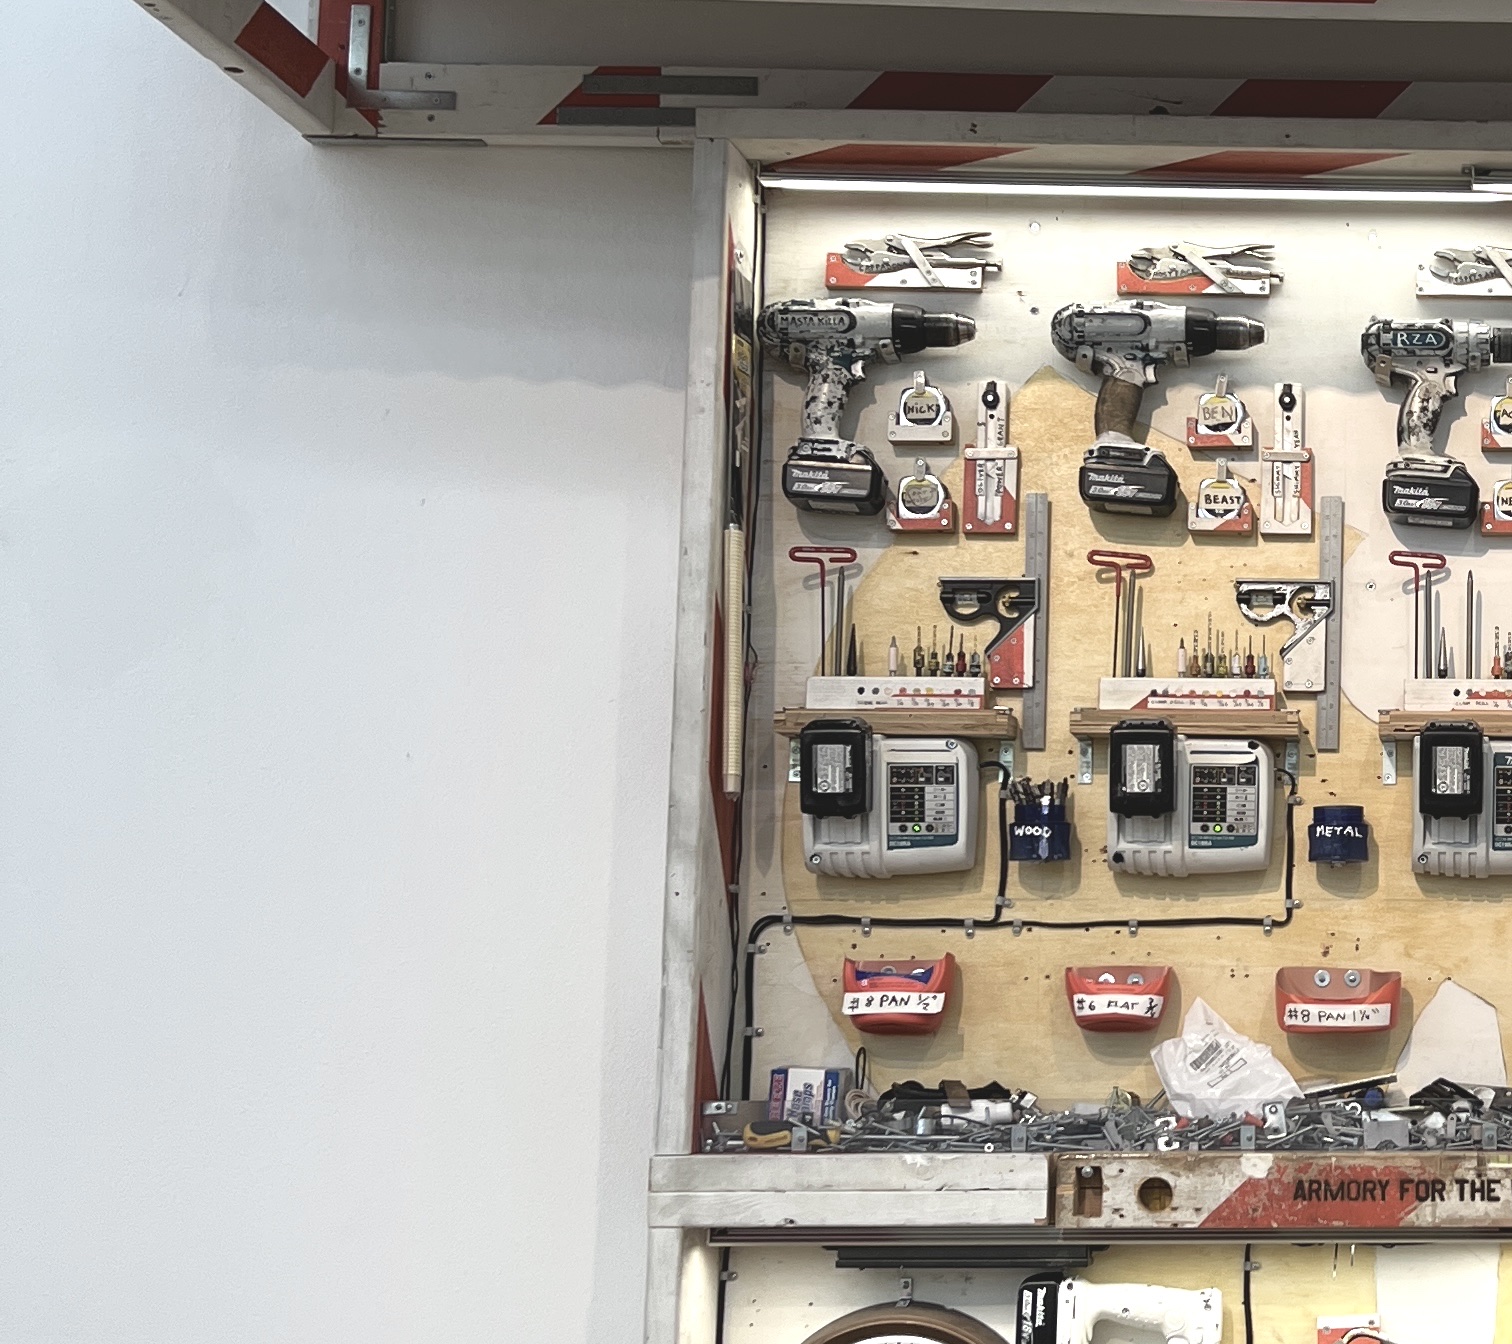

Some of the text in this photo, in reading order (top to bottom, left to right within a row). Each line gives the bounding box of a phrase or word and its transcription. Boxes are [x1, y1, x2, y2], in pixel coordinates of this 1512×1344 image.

[780, 314, 846, 329] MASTA KILLA
[1397, 332, 1438, 347] RZA
[907, 402, 935, 415] NICK
[1202, 406, 1234, 421] BEN
[1204, 492, 1242, 505] BEAST
[1014, 825, 1052, 838] WOOD
[1316, 824, 1363, 838] METAL
[879, 994, 911, 1008] PAN
[1076, 997, 1096, 1012] #6
[1106, 999, 1140, 1011] FLAT
[1287, 1007, 1310, 1023] #8
[1317, 1010, 1346, 1023] PAN
[1293, 1178, 1390, 1202] ARMORY
[1400, 1178, 1446, 1202] FOR
[1455, 1178, 1501, 1202] THE
